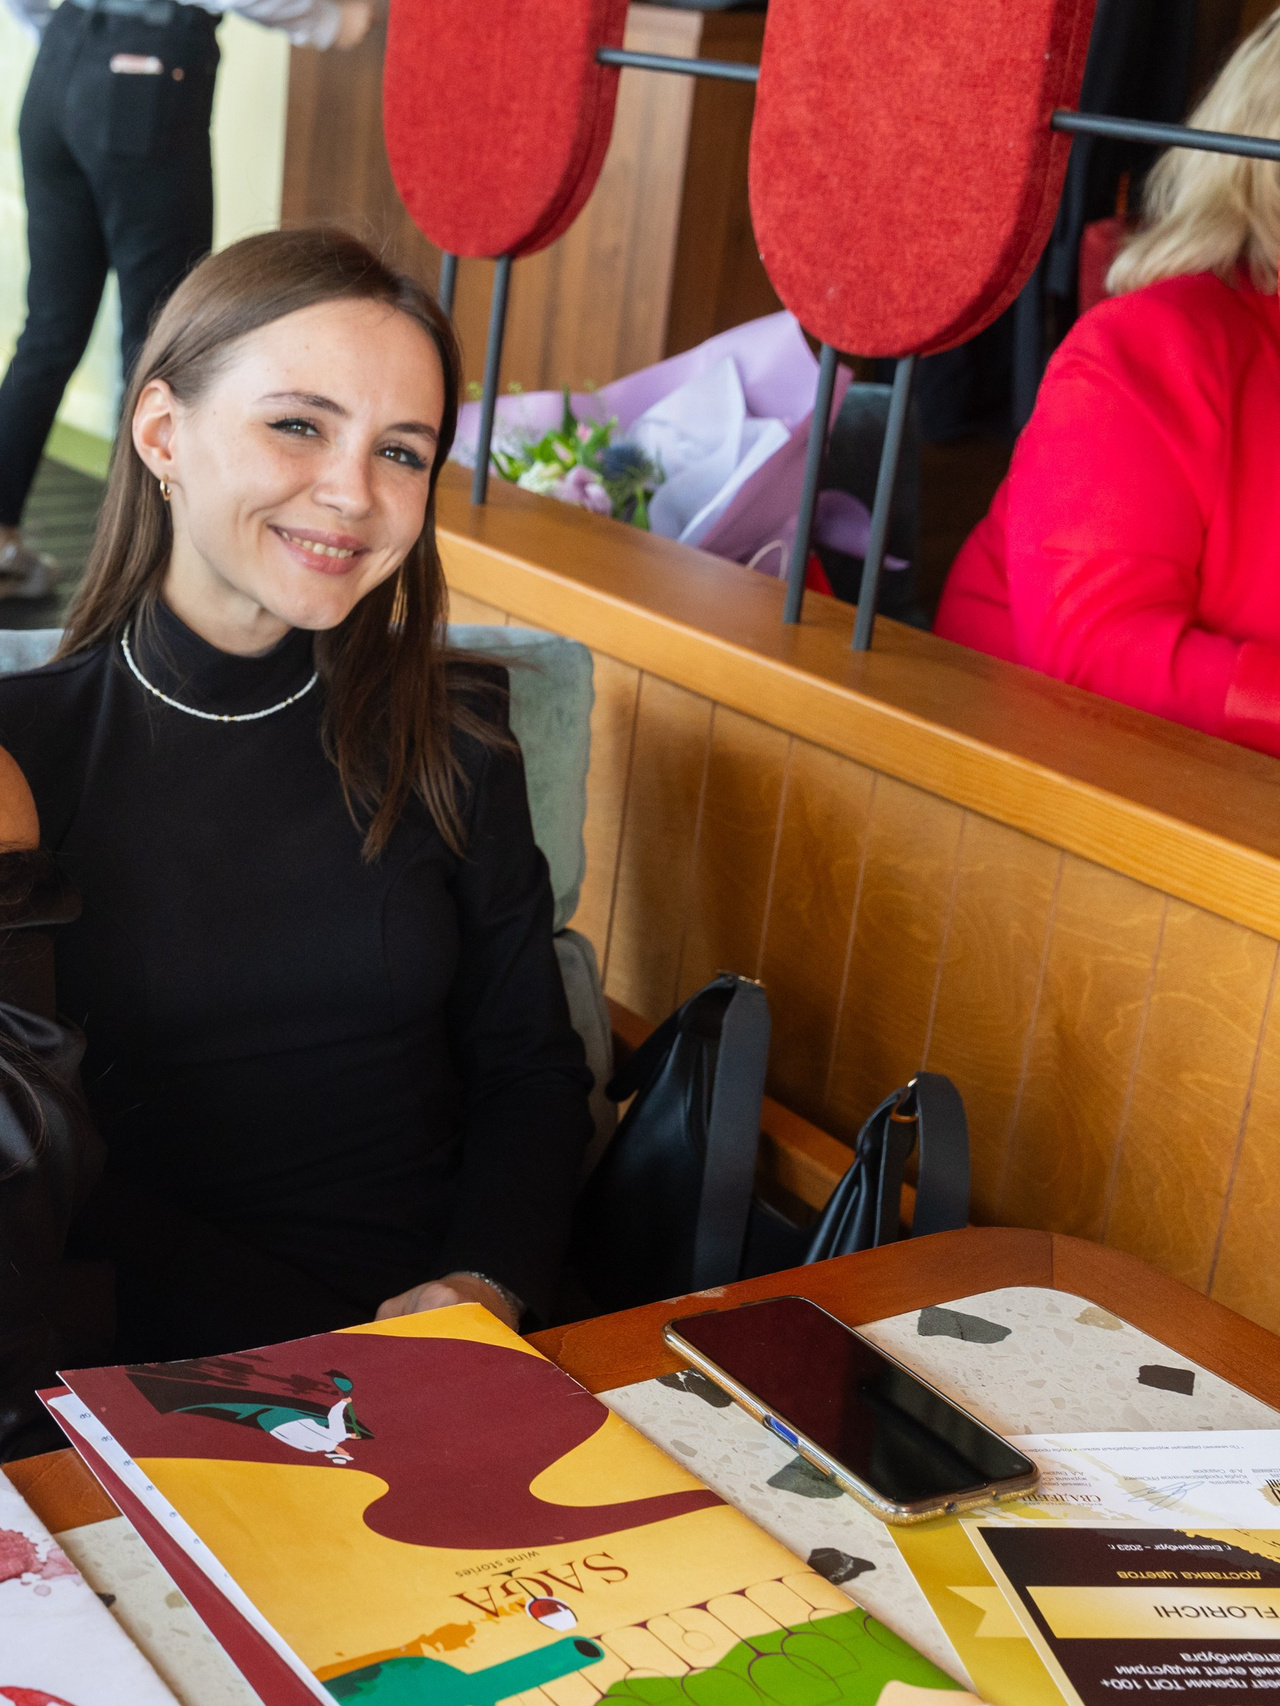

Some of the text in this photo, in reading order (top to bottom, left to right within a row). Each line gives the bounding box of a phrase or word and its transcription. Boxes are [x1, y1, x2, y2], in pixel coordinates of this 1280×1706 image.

[1116, 1543, 1143, 1551] 2023
[1153, 1543, 1223, 1552] Екатеринбург
[454, 1549, 540, 1580] wine stories
[1115, 1569, 1262, 1581] доставка цветов
[449, 1551, 629, 1619] SAGA
[1152, 1605, 1280, 1620] FLORICHI
[1114, 1663, 1202, 1676] индустрии
[1202, 1665, 1247, 1677] event
[1099, 1678, 1142, 1690] 100+
[1144, 1678, 1186, 1691] ТОП
[1184, 1677, 1249, 1689] премии
